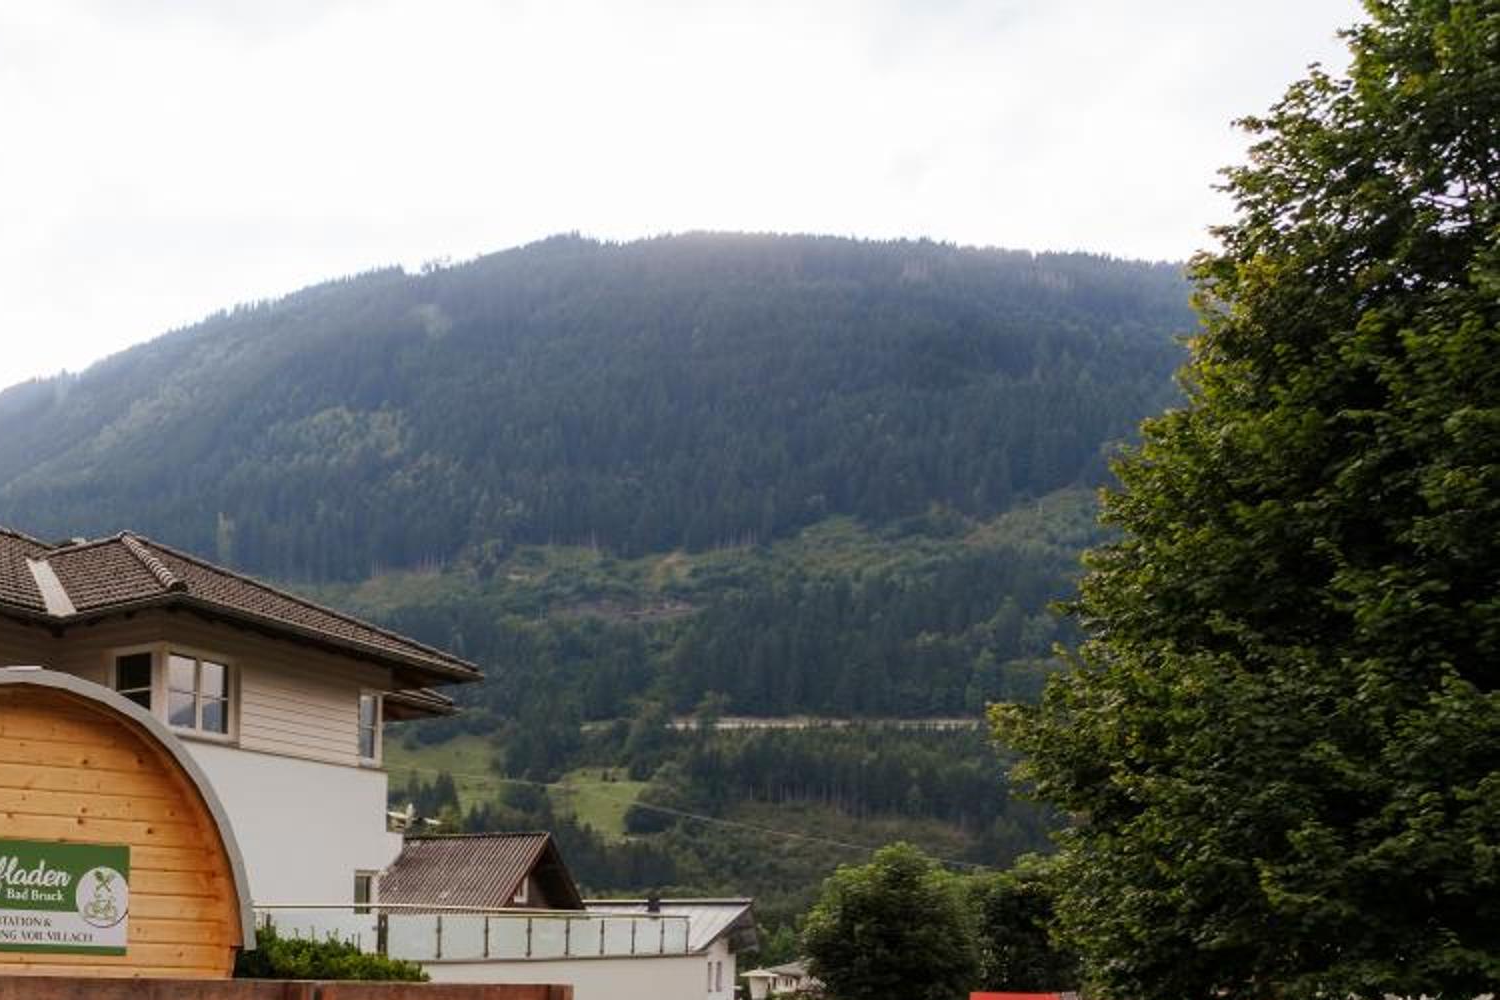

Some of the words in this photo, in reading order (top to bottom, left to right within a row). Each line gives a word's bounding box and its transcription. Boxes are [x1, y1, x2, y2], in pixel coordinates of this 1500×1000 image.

[7, 888, 27, 899] Bad
[31, 889, 65, 901] Bruck
[43, 917, 52, 927] &
[47, 931, 93, 942] VILLACH
